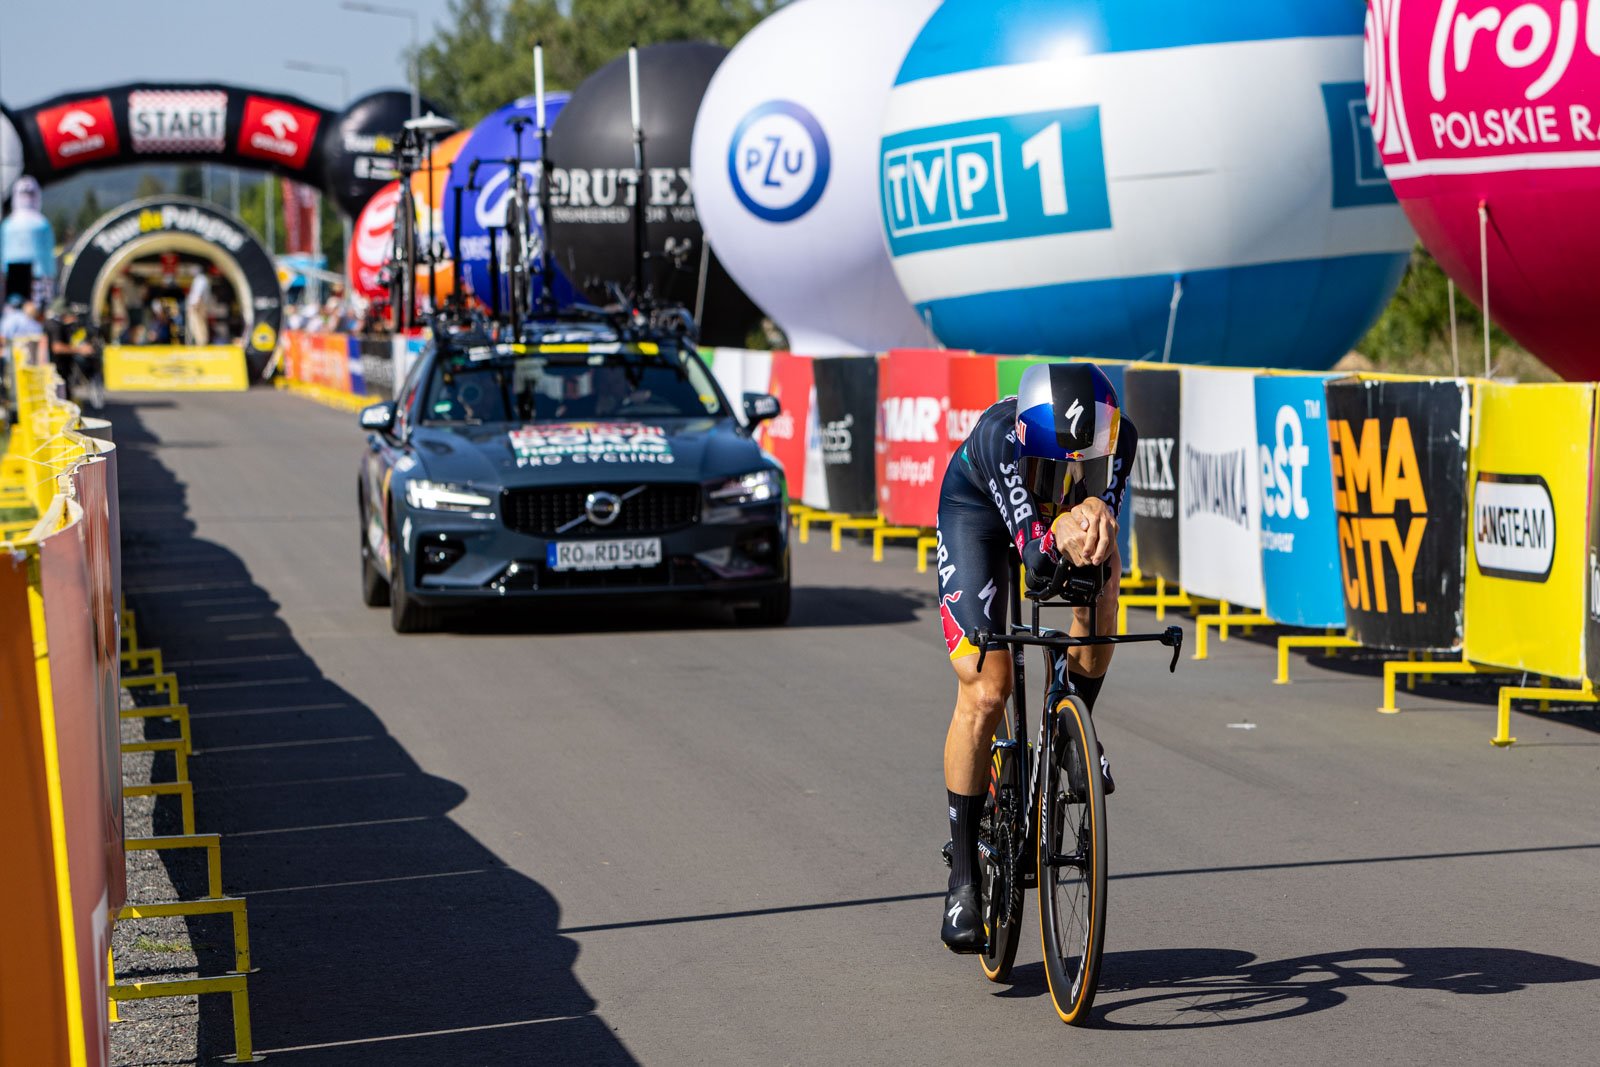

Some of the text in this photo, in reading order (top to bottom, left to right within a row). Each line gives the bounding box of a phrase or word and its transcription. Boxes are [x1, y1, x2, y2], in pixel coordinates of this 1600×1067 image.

[136, 110, 219, 139] START
[1430, 105, 1560, 149] POLSKIE
[745, 135, 804, 188] PZU
[887, 121, 1069, 222] TVP 1
[988, 478, 1013, 536] BORA
[1000, 462, 1033, 525] BOSS
[936, 512, 957, 589] ORA
[1476, 503, 1548, 549] LANGTEAM
[559, 546, 584, 563] RO
